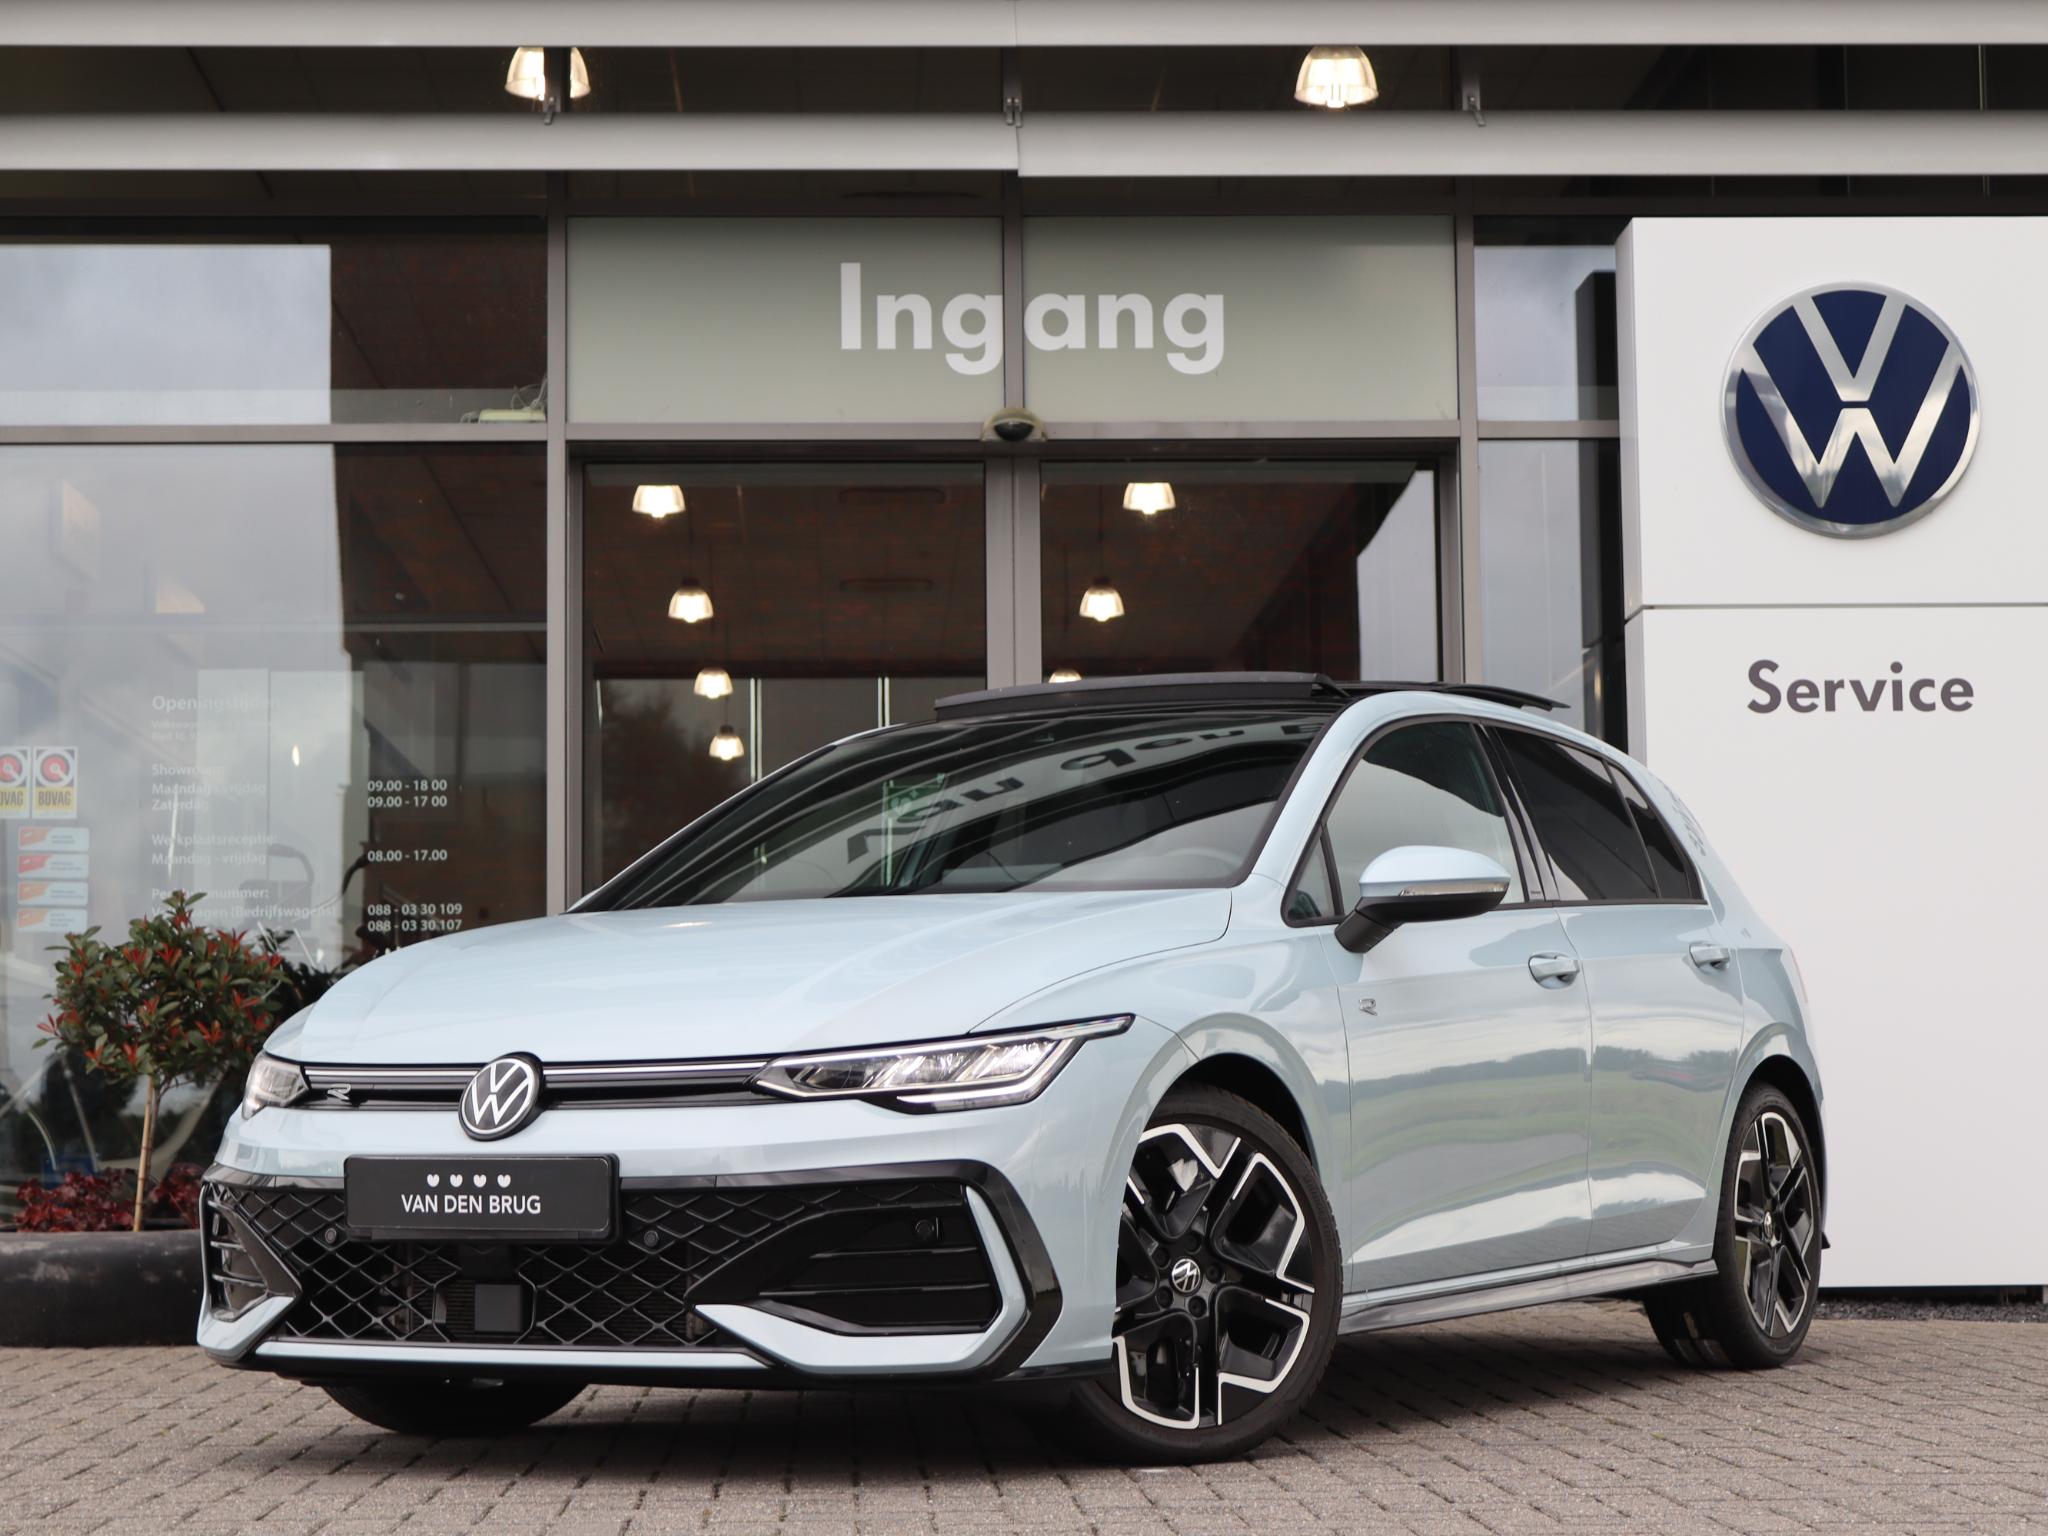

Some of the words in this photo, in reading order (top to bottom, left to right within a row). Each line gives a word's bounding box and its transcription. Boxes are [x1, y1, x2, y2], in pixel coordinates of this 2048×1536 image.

[840, 262, 1225, 376] Ingang
[1747, 659, 1974, 714] Service
[368, 780, 402, 792] 09.00
[38, 791, 72, 806] BOVAG
[368, 797, 402, 808] 09.00
[222, 851, 266, 867] vrijdag
[368, 850, 402, 862] 08.00
[413, 849, 448, 862] 17.00
[368, 904, 391, 916] 088
[401, 904, 417, 915] 03
[420, 904, 436, 915] 30
[440, 903, 463, 915] 109
[368, 920, 391, 932] 088
[401, 920, 417, 931] 03
[420, 920, 436, 931] 30
[440, 919, 463, 931] 107
[401, 1194, 439, 1213] VAN
[444, 1194, 482, 1214] DEN
[489, 1194, 542, 1215] BRUG
